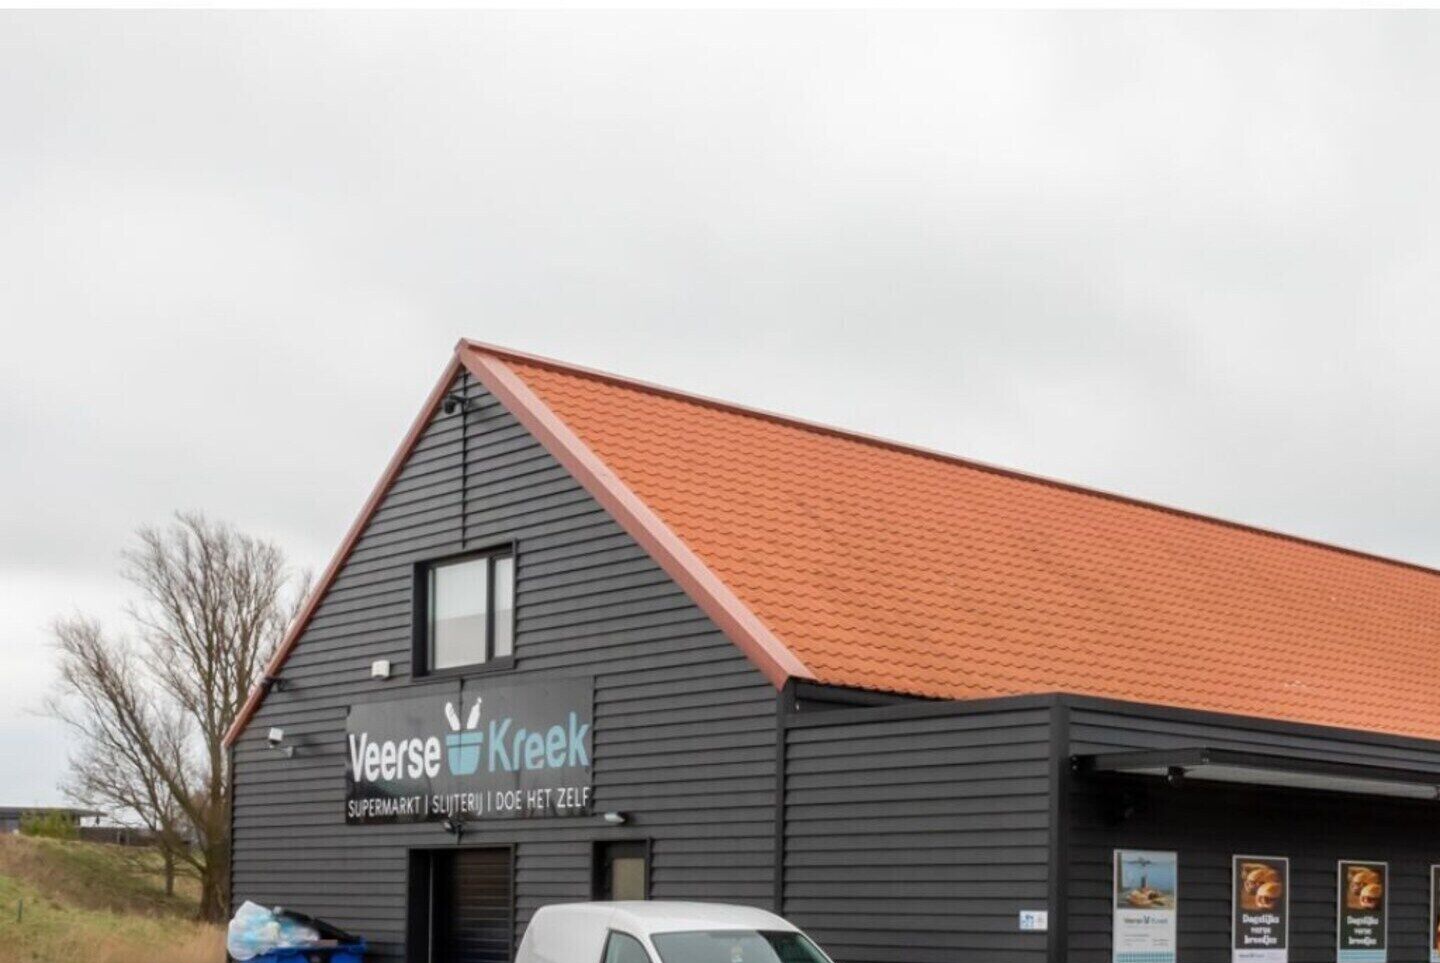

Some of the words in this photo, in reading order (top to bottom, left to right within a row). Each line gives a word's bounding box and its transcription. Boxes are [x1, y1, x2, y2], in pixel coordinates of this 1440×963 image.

[349, 732, 441, 783] Veerse
[488, 711, 590, 772] Kreek
[348, 796, 421, 818] SUPERMARKT
[432, 792, 483, 817] SLIJTERIJ
[495, 790, 522, 810] DOE
[527, 788, 553, 808] HET
[557, 786, 590, 808] ZELF
[1242, 913, 1280, 925] Dagelijks
